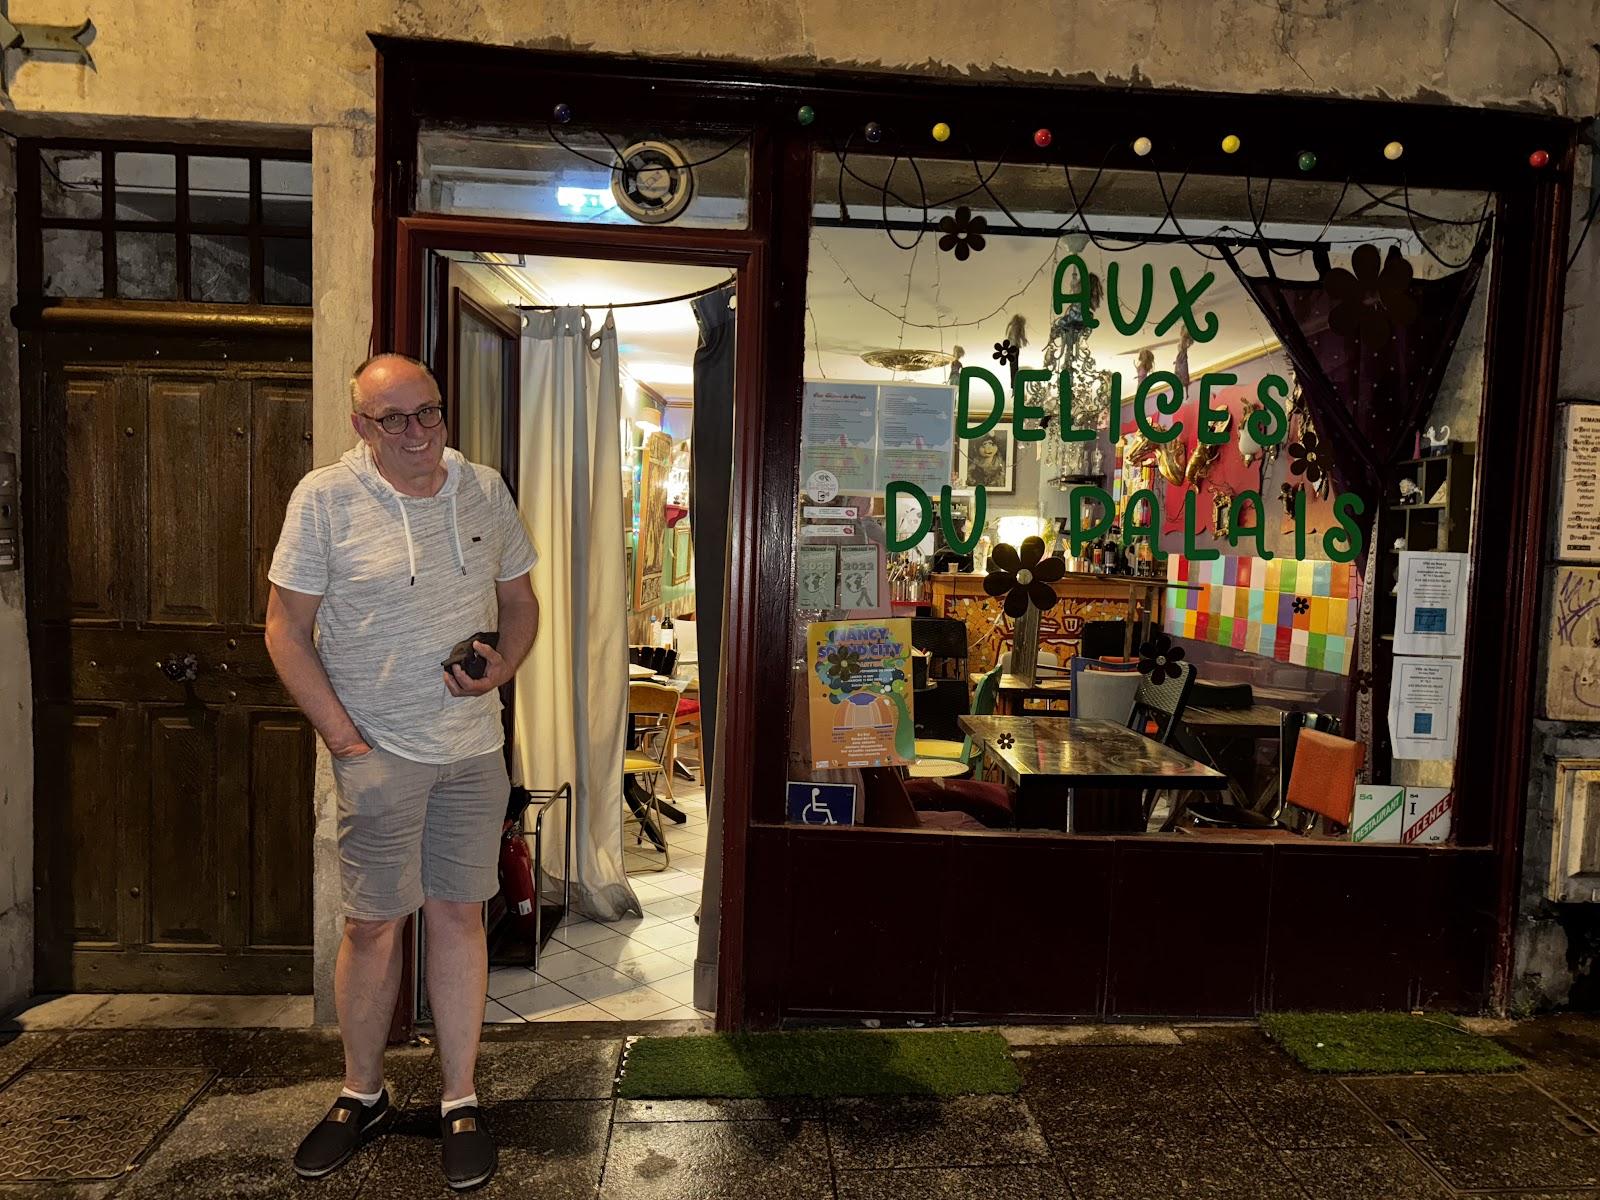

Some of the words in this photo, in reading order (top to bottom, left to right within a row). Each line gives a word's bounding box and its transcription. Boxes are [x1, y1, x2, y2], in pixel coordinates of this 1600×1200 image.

[1053, 253, 1219, 342] AUX
[957, 366, 1288, 446] DELICES
[886, 481, 987, 555] DU
[1070, 485, 1365, 563] PALAIS
[817, 643, 866, 659] SOND
[869, 642, 904, 657] CITY
[832, 628, 888, 641] NANCY
[1355, 796, 1401, 842] RESTAURANT
[1359, 793, 1373, 801] 54
[1405, 796, 1450, 843] LICENCE
